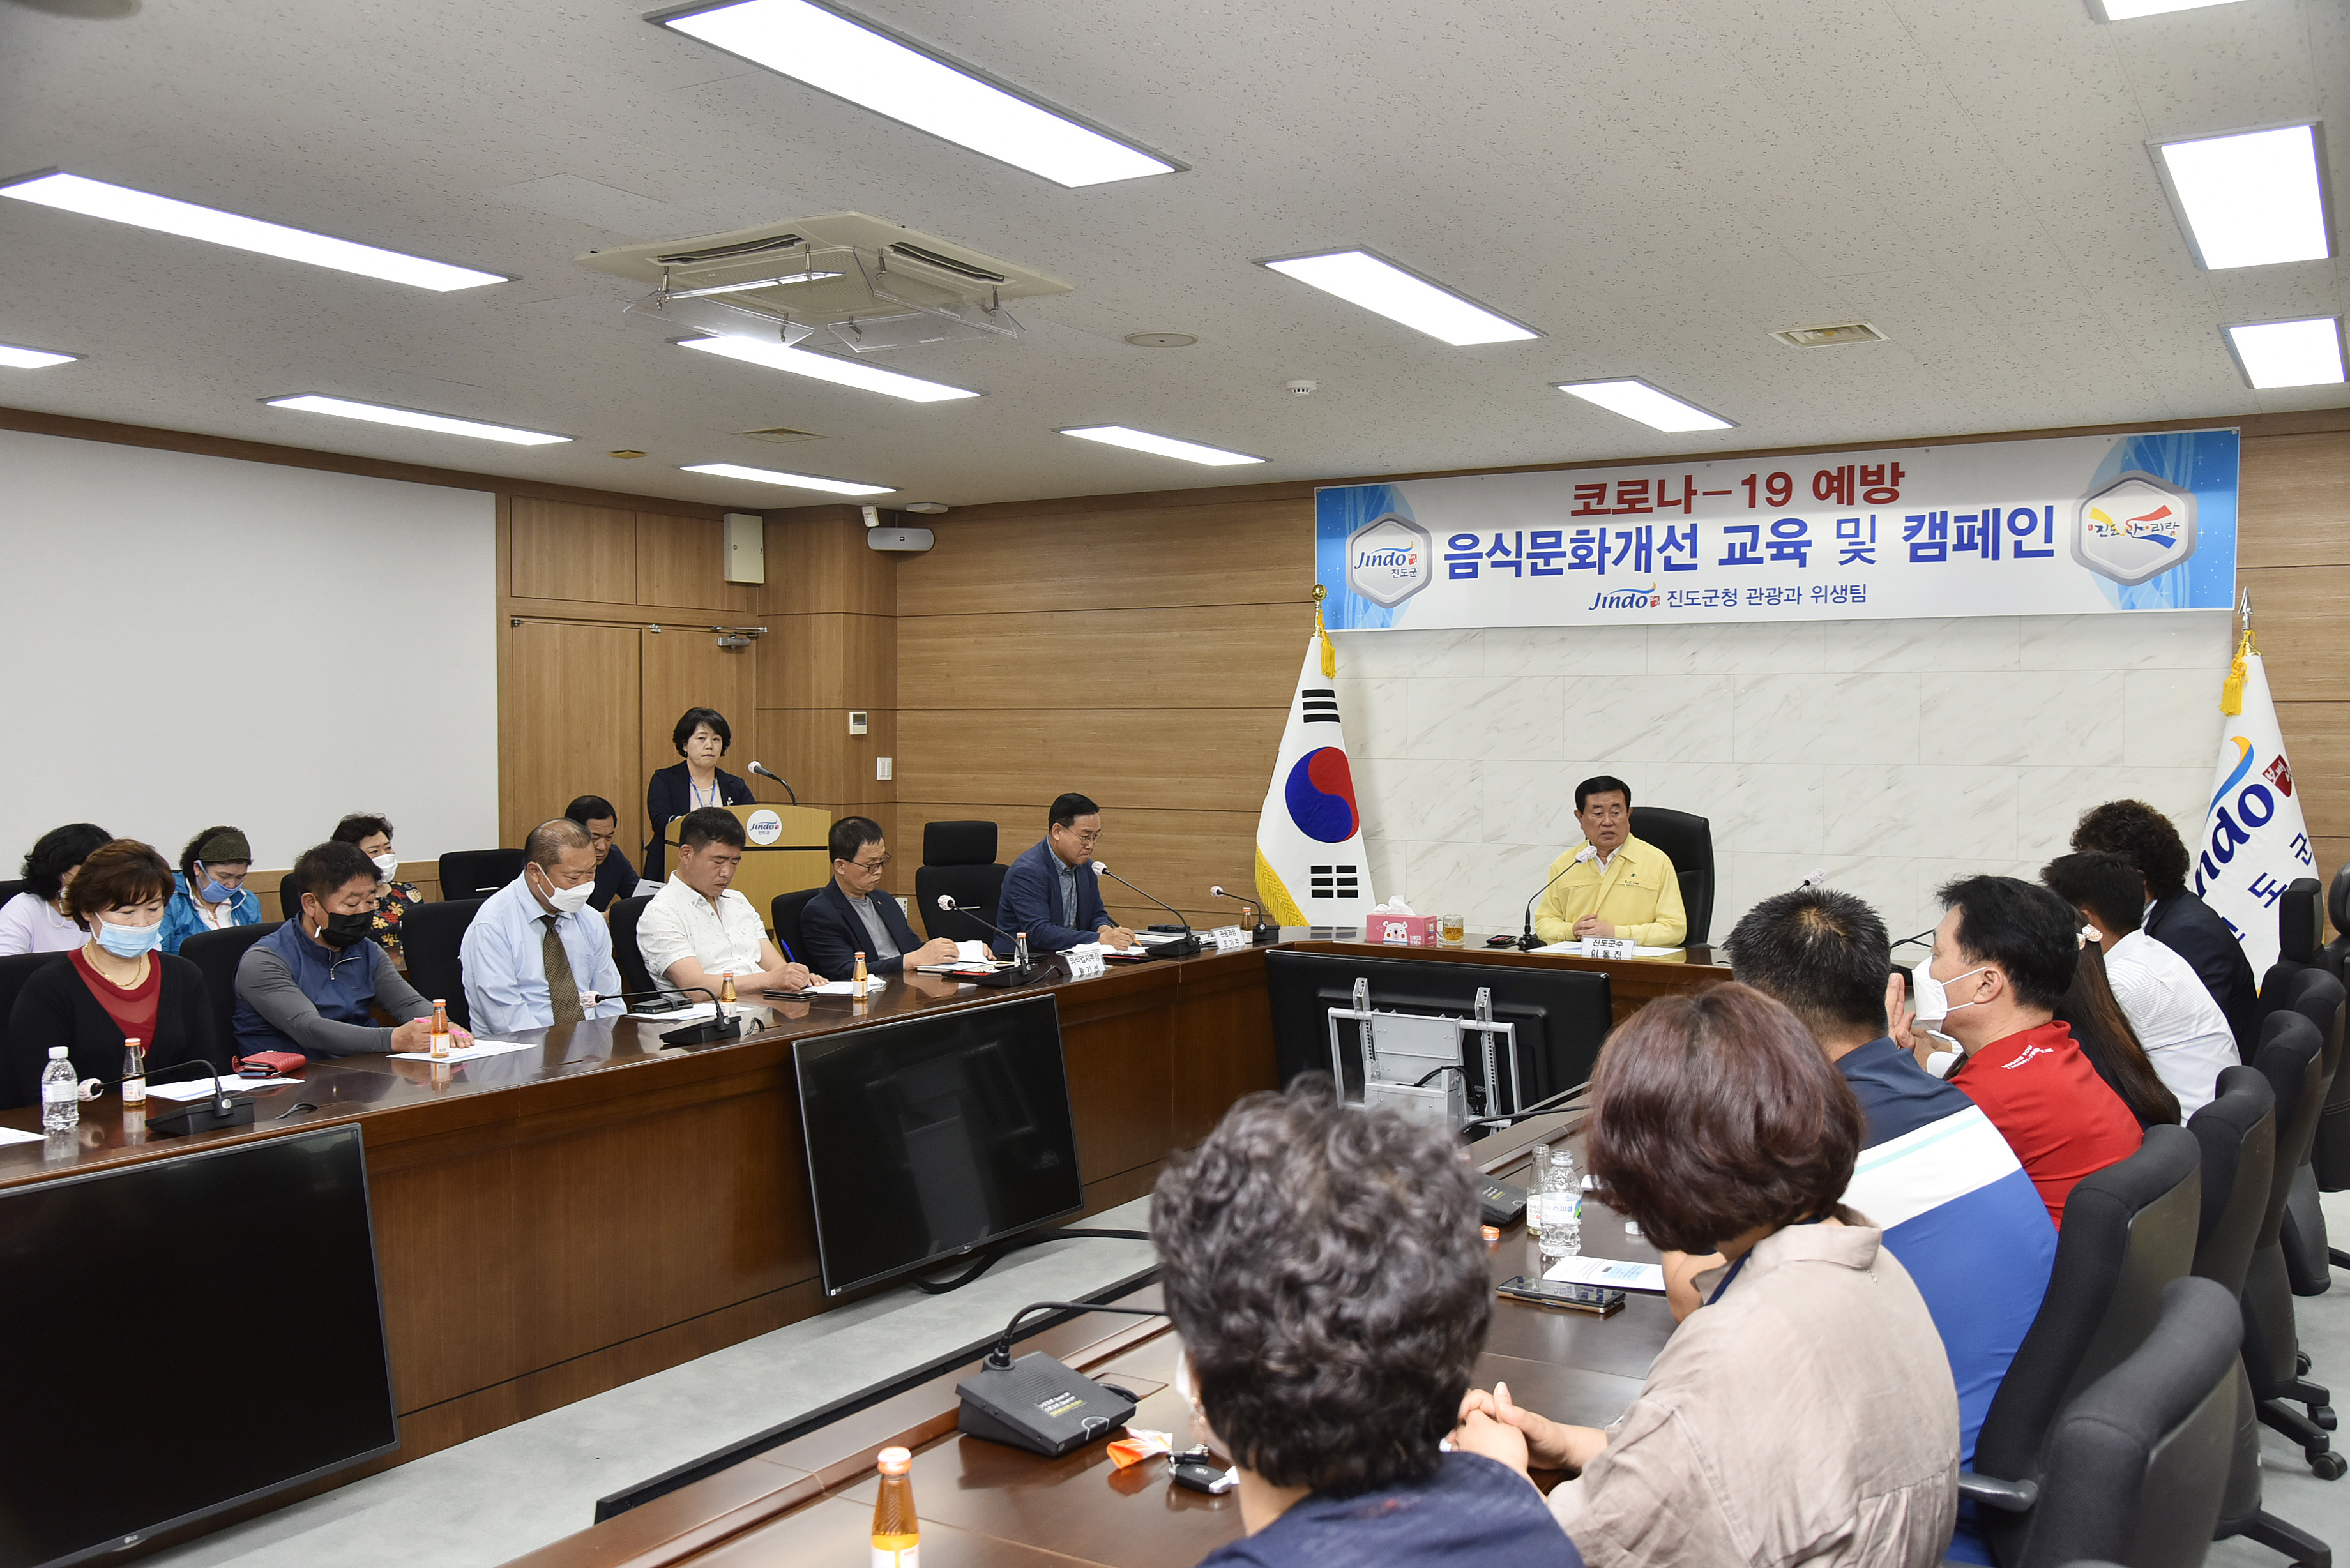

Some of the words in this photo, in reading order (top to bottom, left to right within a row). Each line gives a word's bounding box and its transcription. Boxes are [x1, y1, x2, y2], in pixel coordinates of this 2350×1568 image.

[1570, 471, 1793, 516] 코로나-19
[1812, 462, 1906, 507] 예방
[1444, 523, 1698, 580] 음식문화개선
[1718, 518, 1812, 568] 교육
[1836, 515, 1877, 566] 및
[1902, 505, 2054, 562] 캠페인
[1354, 552, 1406, 569] Jindo
[1391, 568, 1418, 578] 진도군
[1588, 592, 1648, 610] Jindo
[1666, 587, 1738, 608] 진도군청
[1745, 585, 1803, 607] 관광과
[1810, 584, 1867, 604] 위생팀
[2195, 784, 2275, 899] ndo
[1593, 939, 1623, 948] 진도군수
